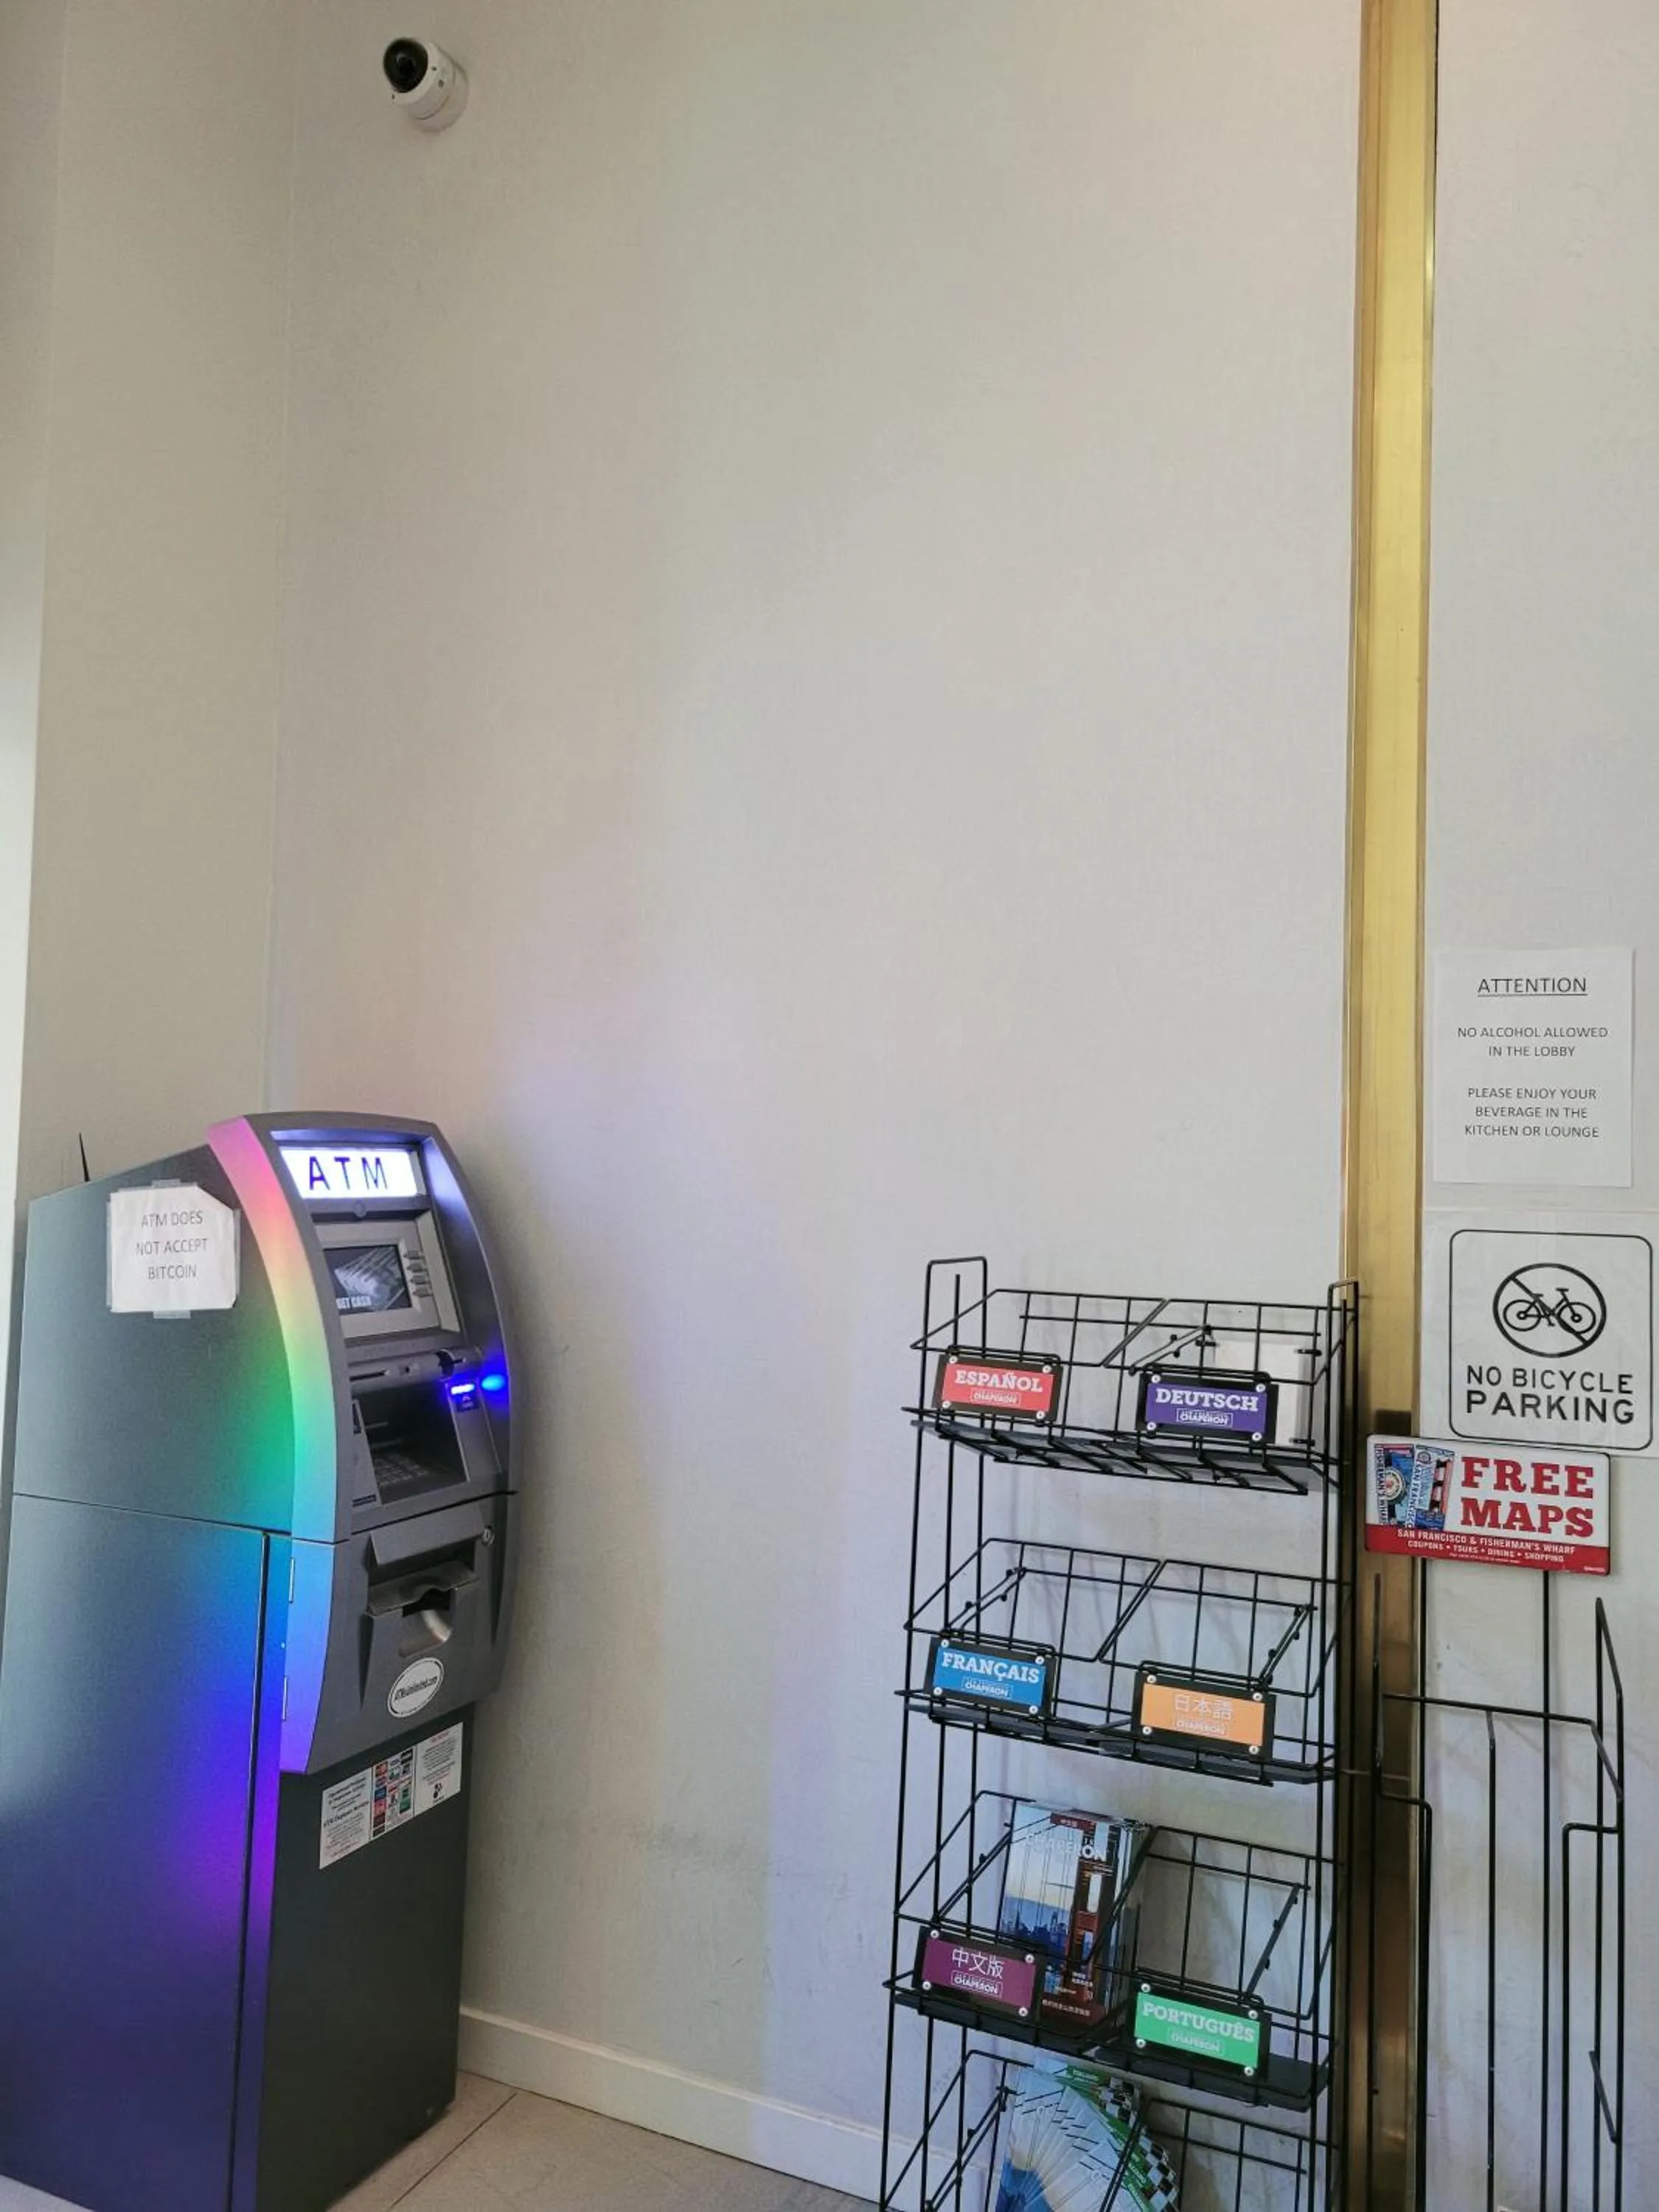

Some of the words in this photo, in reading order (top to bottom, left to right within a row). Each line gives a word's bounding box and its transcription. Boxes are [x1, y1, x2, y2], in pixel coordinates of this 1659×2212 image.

[1477, 977, 1587, 994] ATTENTION
[1457, 1027, 1477, 1037] NO
[1480, 1027, 1541, 1038] ALCOHOL
[1543, 1027, 1608, 1038] ALLOWED
[1488, 1046, 1502, 1057] IN
[1507, 1046, 1530, 1057] THE
[1534, 1046, 1576, 1057] LOBBY
[1468, 1088, 1512, 1099] PLEASE
[1517, 1088, 1557, 1099] ENJOY
[1559, 1089, 1597, 1100] YOUR
[1475, 1107, 1542, 1119] BEVERAGE
[1545, 1107, 1559, 1118] IN
[1563, 1107, 1587, 1119] THE
[1465, 1124, 1519, 1136] KITCHEN
[1522, 1126, 1541, 1137] OR
[1545, 1126, 1599, 1138] LOUNGE
[309, 1155, 389, 1191] ATM
[141, 1213, 167, 1228] ATM
[171, 1211, 204, 1225] DOES
[136, 1241, 161, 1256] NOT
[164, 1238, 209, 1255] ACCEPT
[147, 1265, 198, 1280] BITCOIN
[954, 1369, 1044, 1393] ESPAÑOL
[1467, 1364, 1502, 1385] NO
[1512, 1368, 1634, 1394] BICYCLE
[1155, 1388, 1259, 1412] DEUTSCH
[1466, 1390, 1635, 1425] PARKING
[1461, 1455, 1594, 1499] FREE
[1461, 1495, 1594, 1538] MAPS
[1397, 1528, 1415, 1538] SAN
[1418, 1530, 1467, 1544] FRANCISCO
[1543, 1543, 1576, 1554] WHARF
[1524, 1551, 1565, 1562] SHOPPING
[942, 1652, 1040, 1684] FRANÇAIS
[1174, 1694, 1234, 1721] 日本語
[952, 1947, 1006, 1980] 中文版
[1143, 2002, 1255, 2042] PORTUGUÊS
